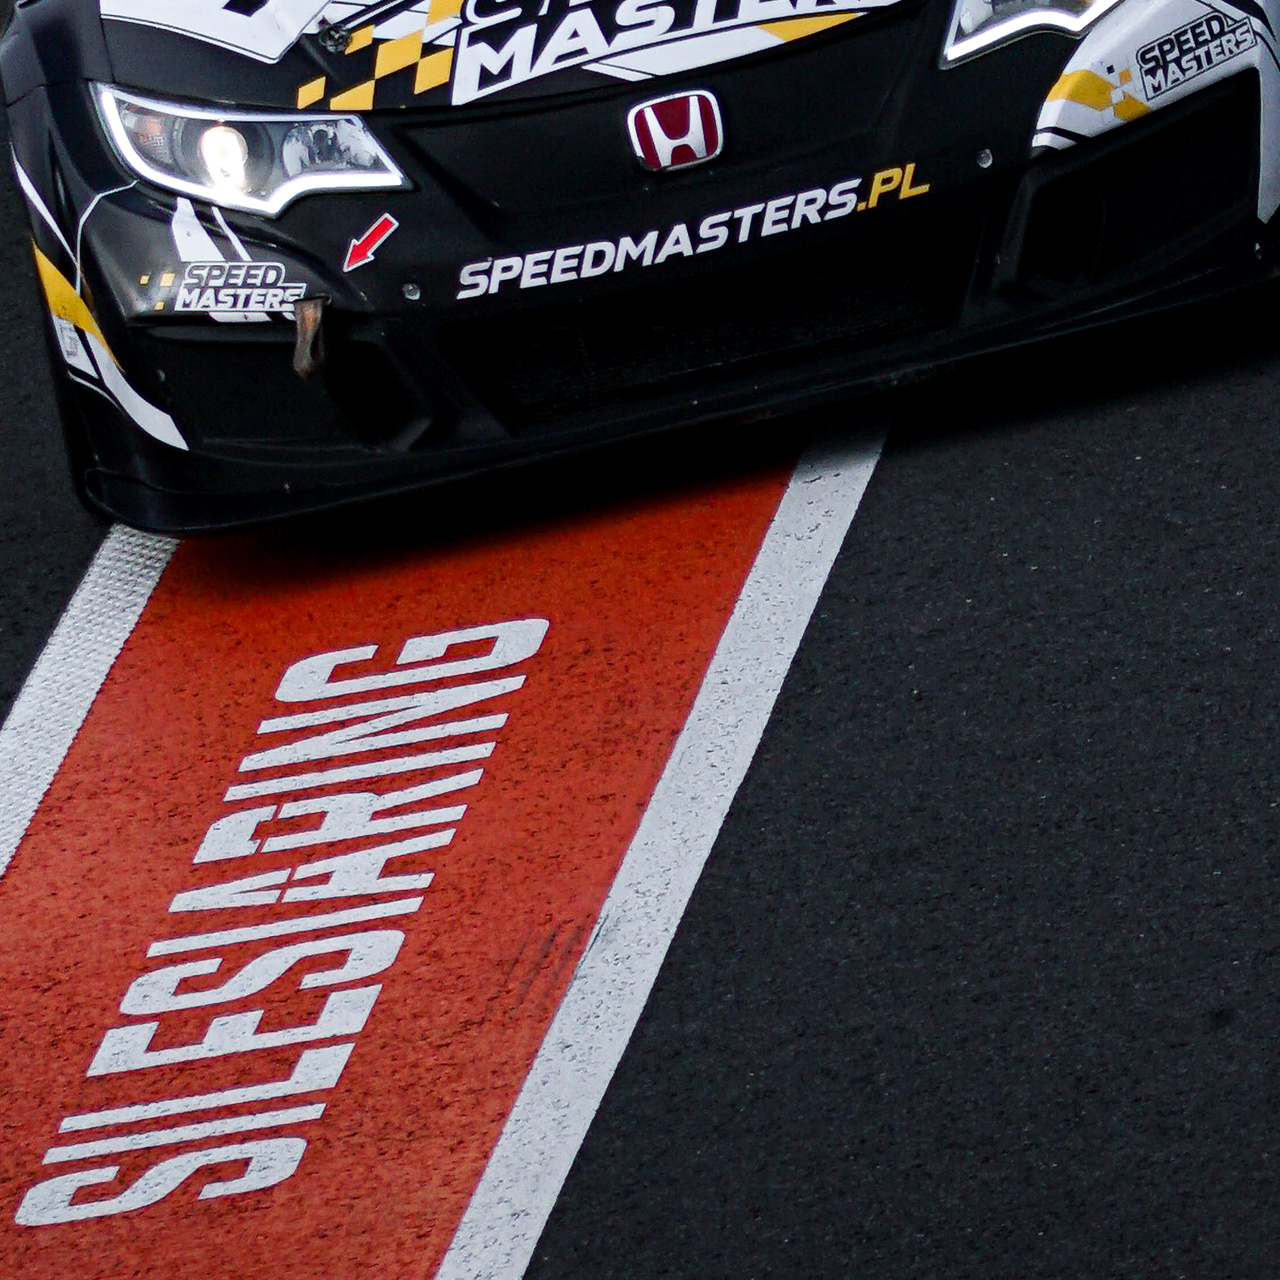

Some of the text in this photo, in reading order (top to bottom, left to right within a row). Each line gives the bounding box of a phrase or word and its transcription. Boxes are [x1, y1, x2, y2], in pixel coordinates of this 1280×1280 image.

[1139, 14, 1226, 68] SPEED
[1143, 21, 1253, 98] MASTERS
[456, 163, 930, 300] SPEEDMASTERS.PL
[174, 287, 303, 311] MASTERS
[187, 264, 283, 287] SPEED
